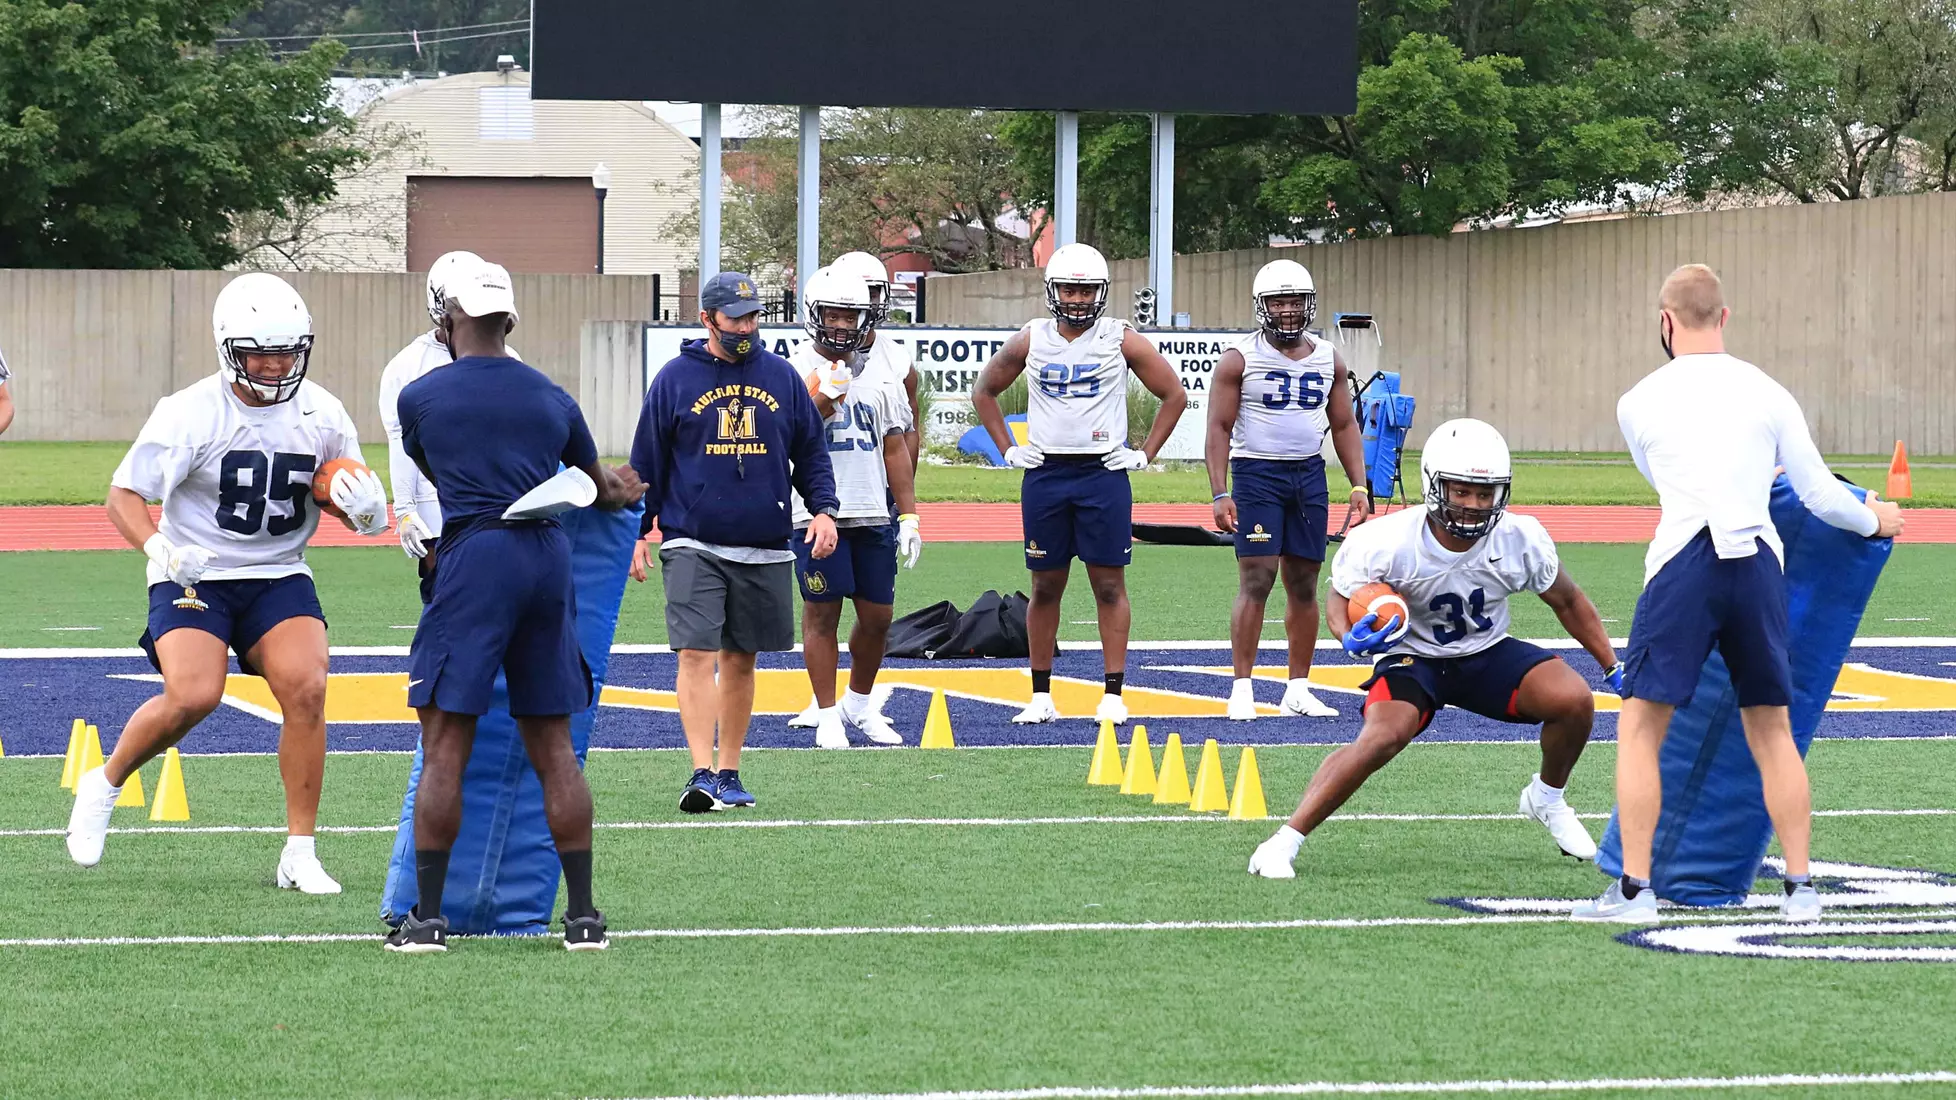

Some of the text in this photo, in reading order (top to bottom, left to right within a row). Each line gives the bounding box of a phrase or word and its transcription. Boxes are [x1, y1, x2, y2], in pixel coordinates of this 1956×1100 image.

[1158, 341, 1225, 355] MURRA
[1039, 363, 1102, 398] 85
[1262, 370, 1325, 410] 36
[691, 384, 780, 416] MURRAY STATE
[824, 400, 879, 452] 29
[705, 443, 767, 455] FOOTBALL
[215, 449, 317, 537] 85
[1428, 586, 1494, 646] 31
